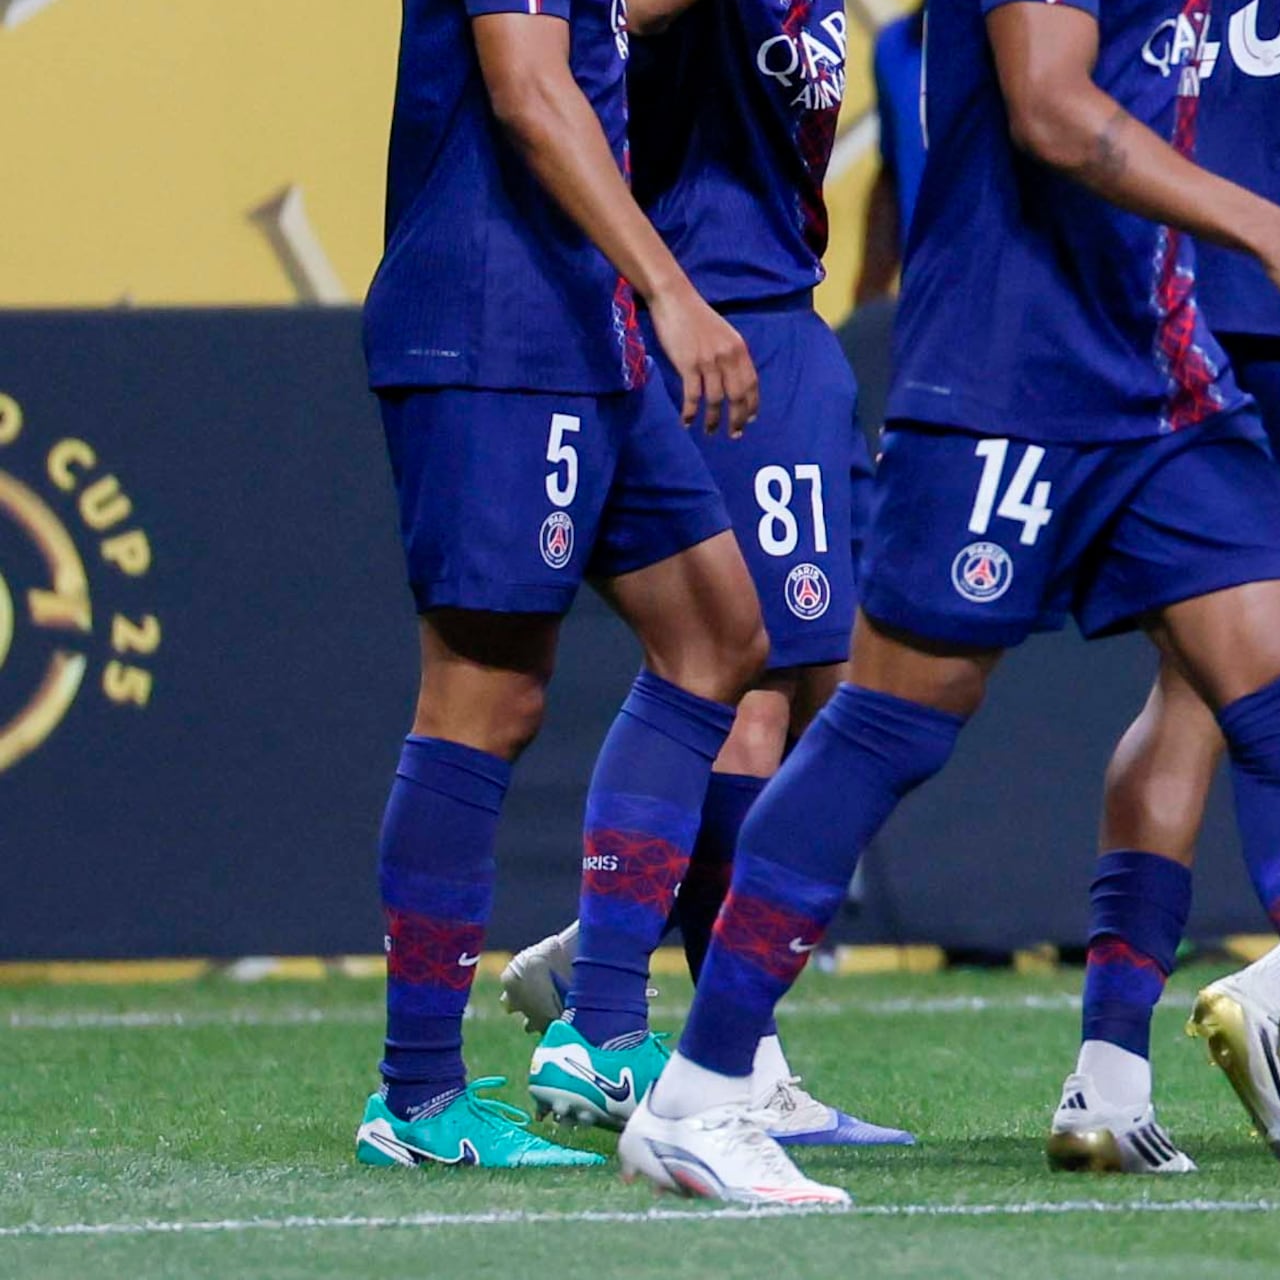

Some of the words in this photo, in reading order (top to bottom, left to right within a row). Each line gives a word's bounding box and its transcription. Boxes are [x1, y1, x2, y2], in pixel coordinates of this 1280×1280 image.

[545, 413, 580, 508] 5
[968, 438, 1053, 546] 14
[755, 464, 828, 556] 87
[46, 437, 151, 577] CUP
[102, 613, 161, 707] 25
[791, 566, 820, 583] PARIS
